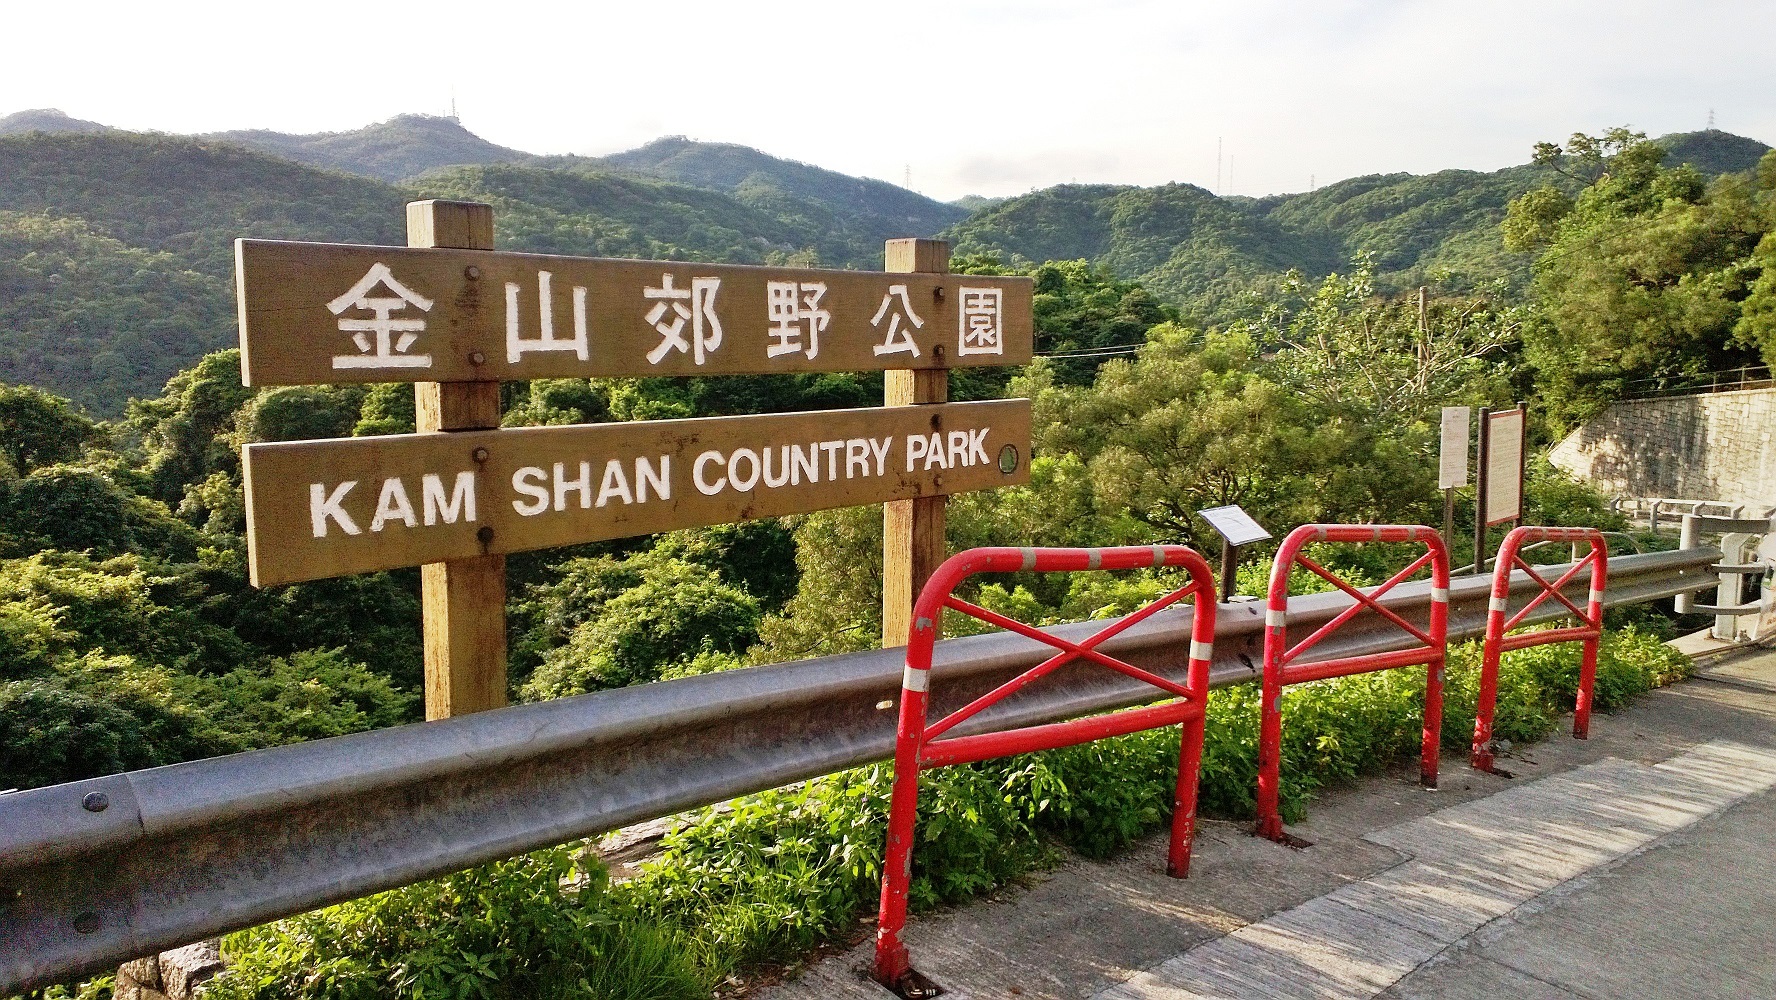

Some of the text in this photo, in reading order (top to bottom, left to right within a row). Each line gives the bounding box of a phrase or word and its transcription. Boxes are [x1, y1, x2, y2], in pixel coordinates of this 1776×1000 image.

[326, 262, 1003, 369] 金山郊野公園
[309, 427, 991, 538] KAM SHAN COUNTRY PARK
